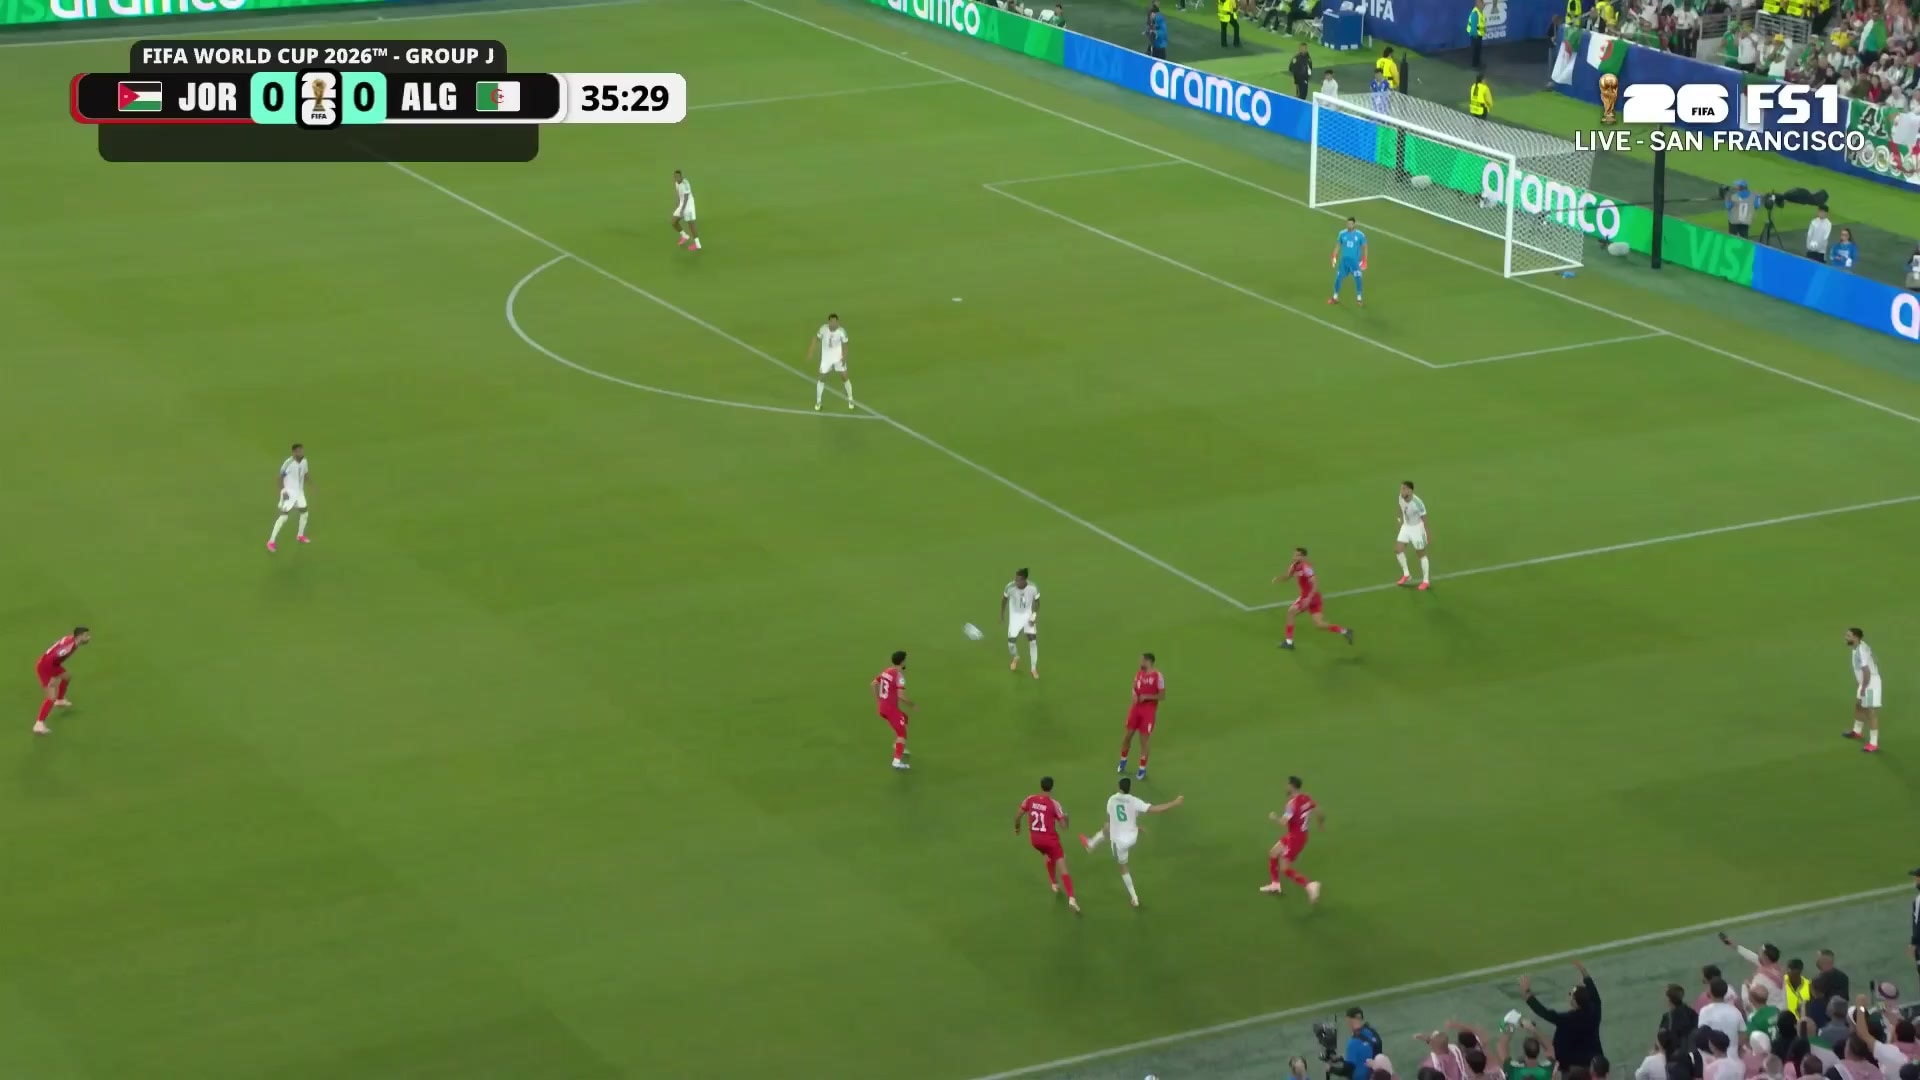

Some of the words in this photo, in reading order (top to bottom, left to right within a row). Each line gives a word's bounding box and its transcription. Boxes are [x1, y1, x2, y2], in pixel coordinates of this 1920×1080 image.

[1150, 62, 1271, 126] aramco
[1031, 811, 1047, 832] 21
[1116, 804, 1127, 822] 6
